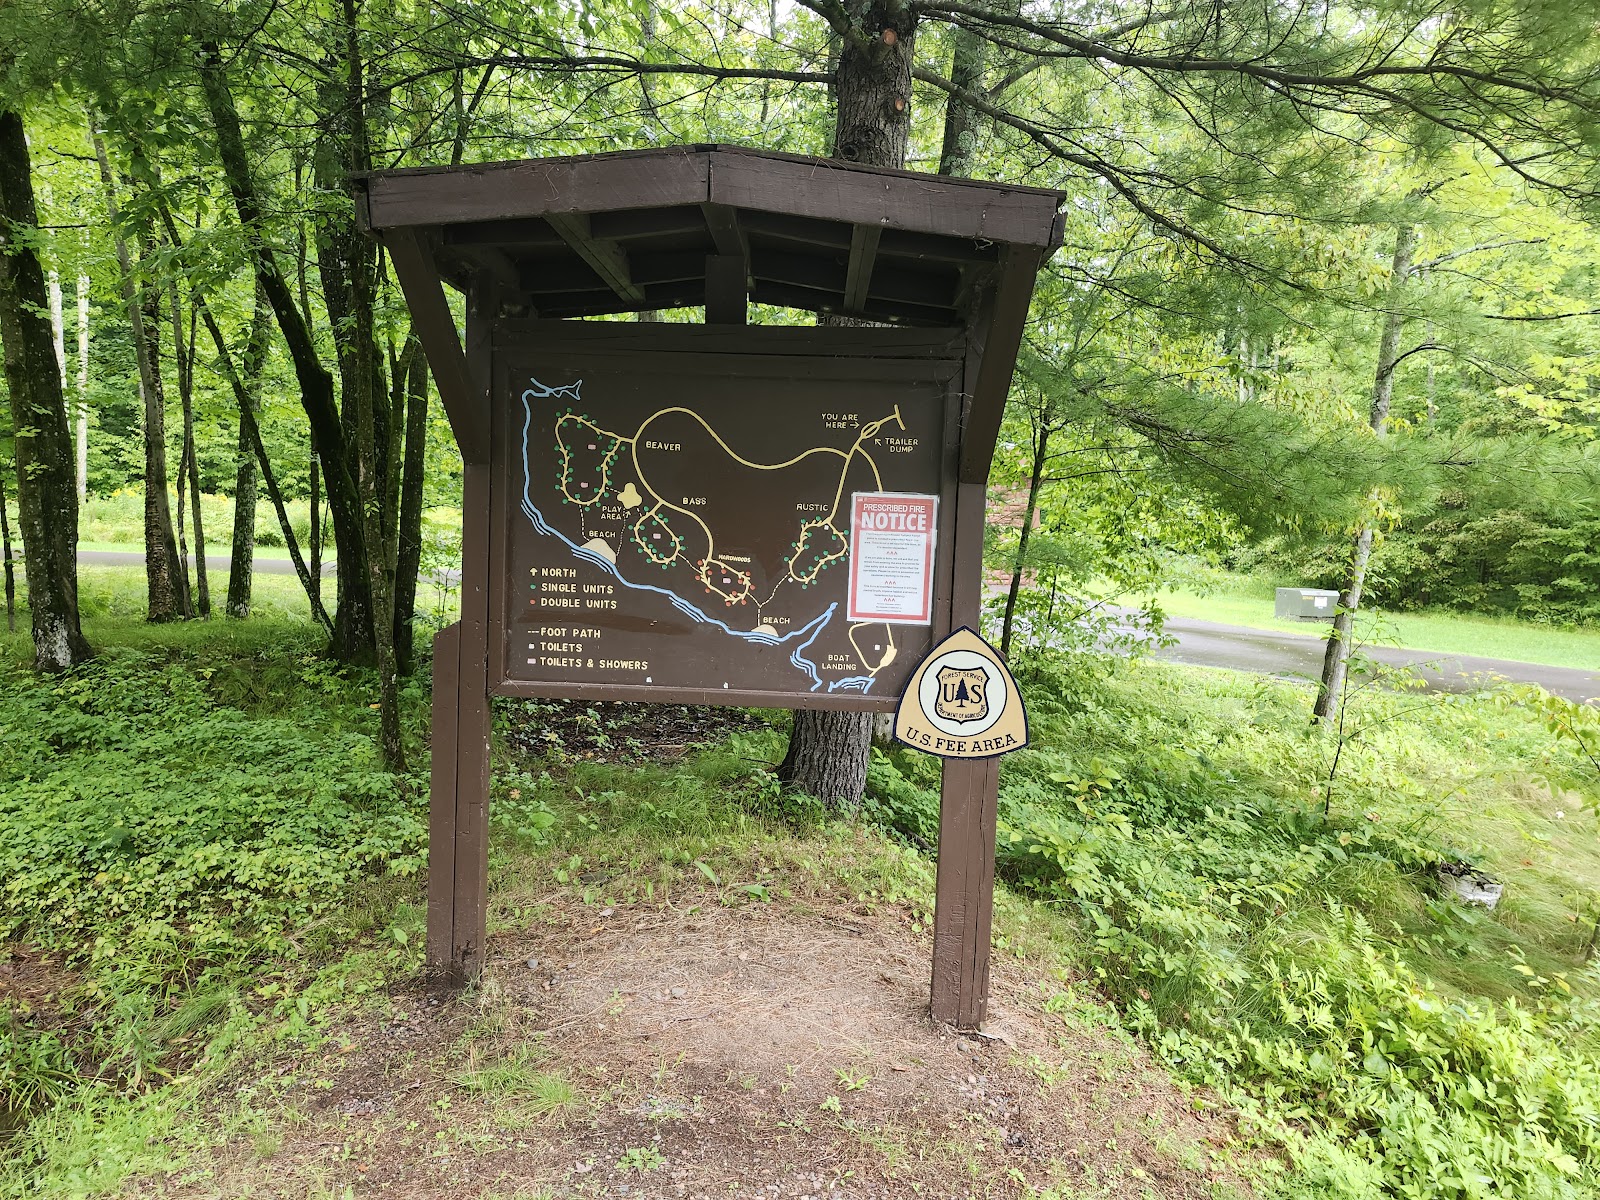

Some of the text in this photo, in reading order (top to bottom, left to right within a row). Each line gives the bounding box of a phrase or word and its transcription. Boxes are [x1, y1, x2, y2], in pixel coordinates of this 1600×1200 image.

[646, 441, 681, 451] BEAVER
[885, 437, 919, 446] TRAILER
[796, 503, 829, 511] RUSTIC
[864, 503, 925, 513] PRESCRIBED FIRE
[861, 512, 927, 531] NOTICE
[589, 530, 616, 538] BEACH
[718, 554, 751, 563] HARDWOODS
[541, 568, 576, 577] NORTH
[541, 583, 614, 594] SINGLE UNITS
[540, 598, 617, 609] DOUBLE UNITS
[763, 616, 790, 624] BEACH
[540, 627, 601, 638] FOOT PATH
[540, 642, 583, 652] TOILETS
[540, 656, 648, 670] TOILETS & SHOWERS
[828, 654, 850, 662] BOAT
[941, 671, 984, 683] FOREST SERVICE
[943, 683, 983, 704] U S
[906, 727, 1018, 752] U.S. FEE AREA
